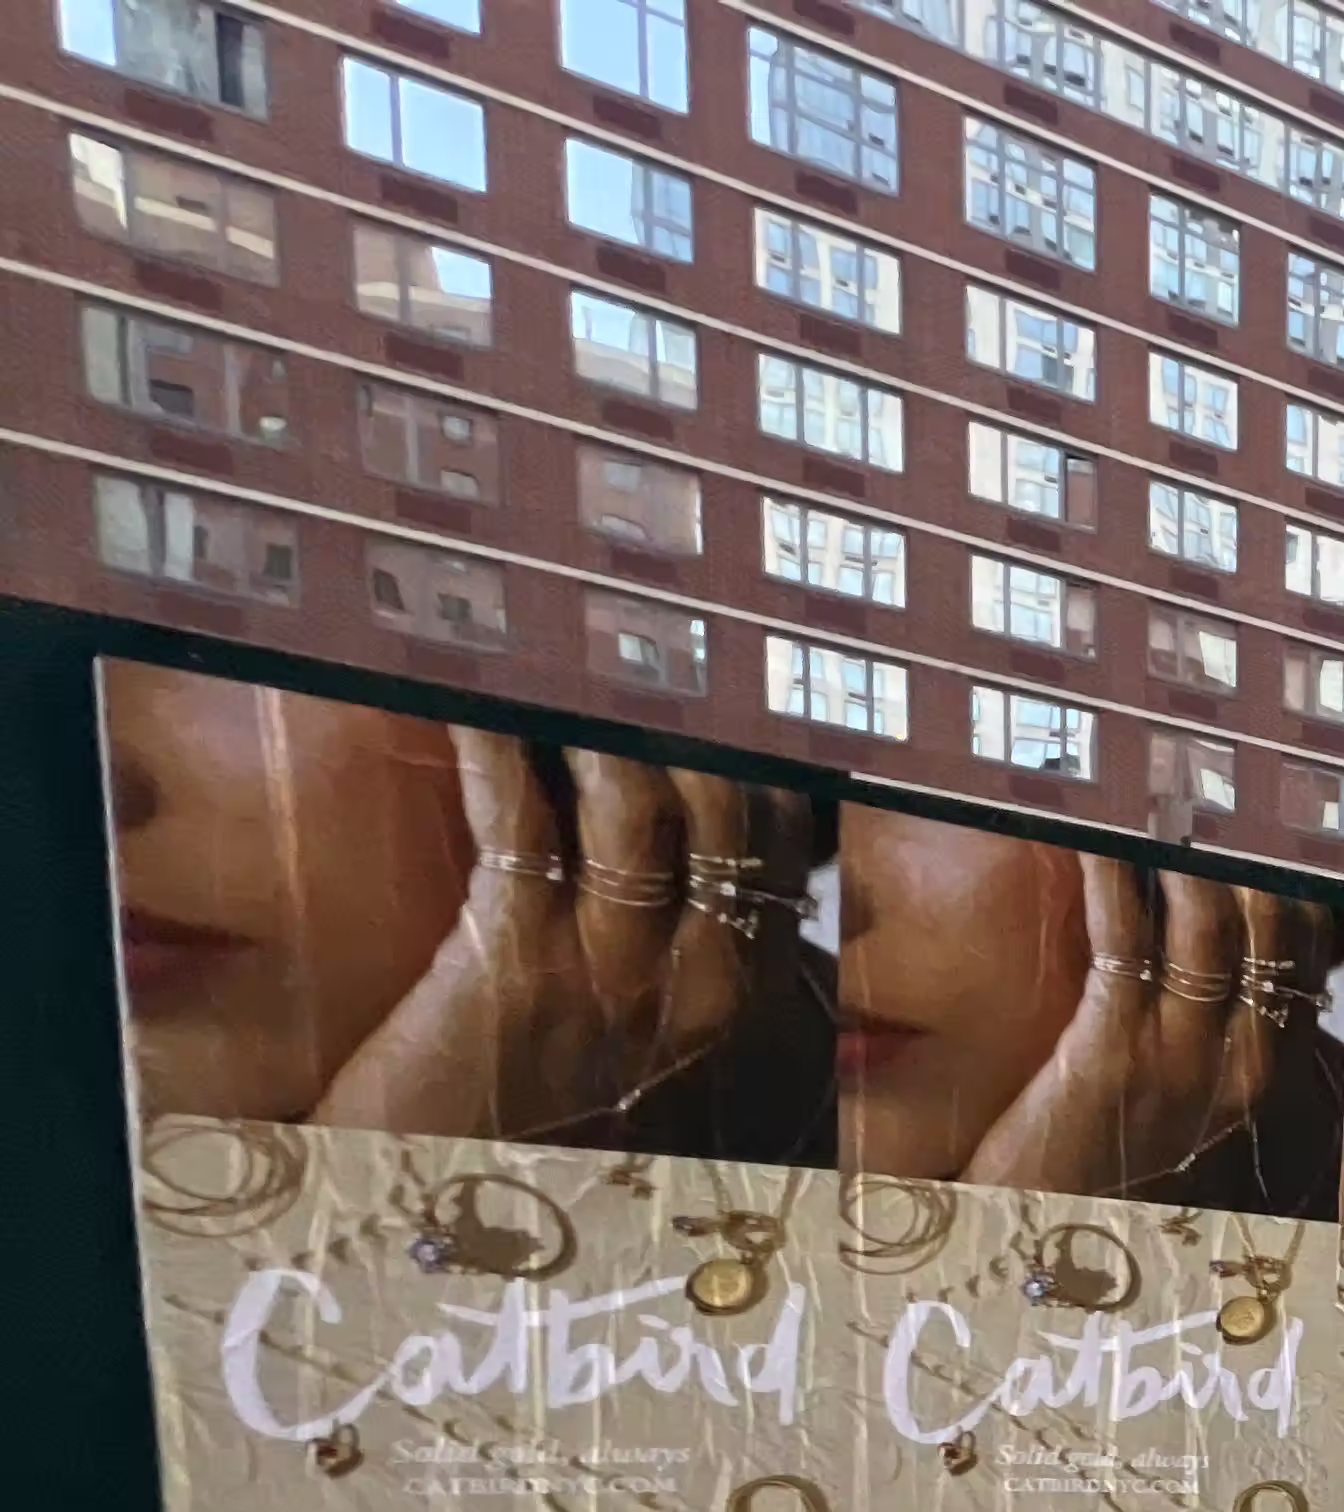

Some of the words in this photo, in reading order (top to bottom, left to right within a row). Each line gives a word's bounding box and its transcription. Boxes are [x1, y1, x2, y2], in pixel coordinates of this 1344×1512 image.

[220, 1268, 805, 1440] Catbird
[882, 1300, 1304, 1444] Catbird
[392, 1438, 479, 1464] Solid
[579, 1439, 690, 1472] always
[995, 1443, 1063, 1466] Solid
[1130, 1447, 1209, 1475] always
